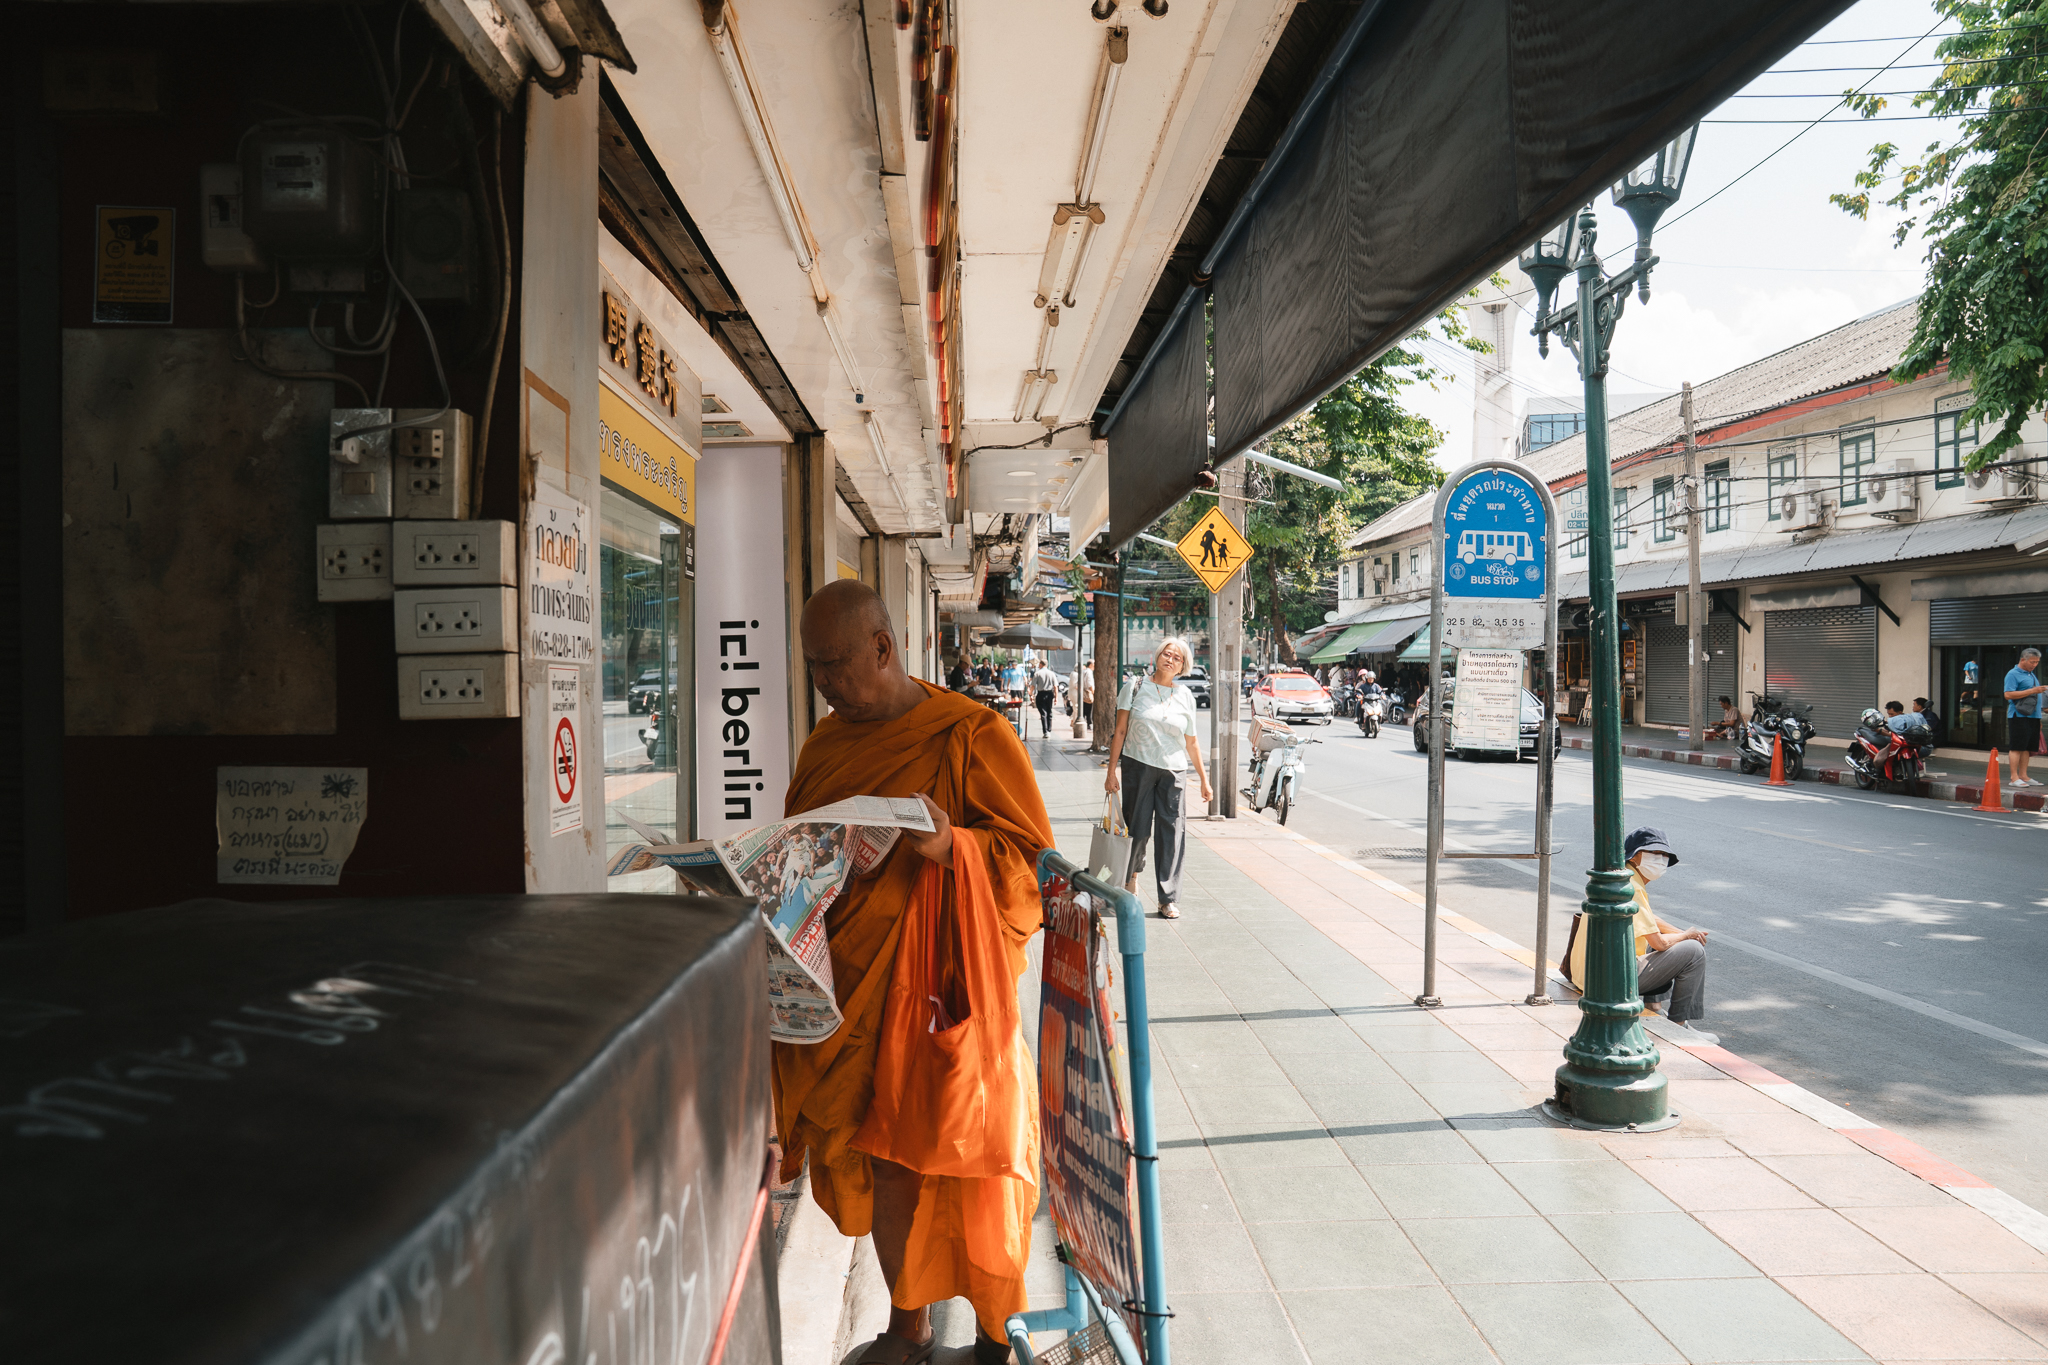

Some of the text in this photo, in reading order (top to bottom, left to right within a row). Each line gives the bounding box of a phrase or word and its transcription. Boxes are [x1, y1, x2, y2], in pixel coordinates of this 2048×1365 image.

[599, 420, 688, 514] ทรงพระเจริญ
[1451, 478, 1535, 523] ที่หยุดรถประจำทาง
[1486, 502, 1506, 511] หมวด
[536, 506, 587, 575] กล้วยปิ้ง
[531, 567, 590, 624] ท่าพระจันทร์
[1470, 576, 1519, 585] BUS STOP
[532, 630, 591, 660] 065-828-1709
[719, 619, 759, 671] ic!
[1462, 660, 1518, 669] ป้ายหยุดรถโดยสาร
[1469, 651, 1513, 660] โครงการก่อสร้าง
[721, 687, 764, 820] berlin
